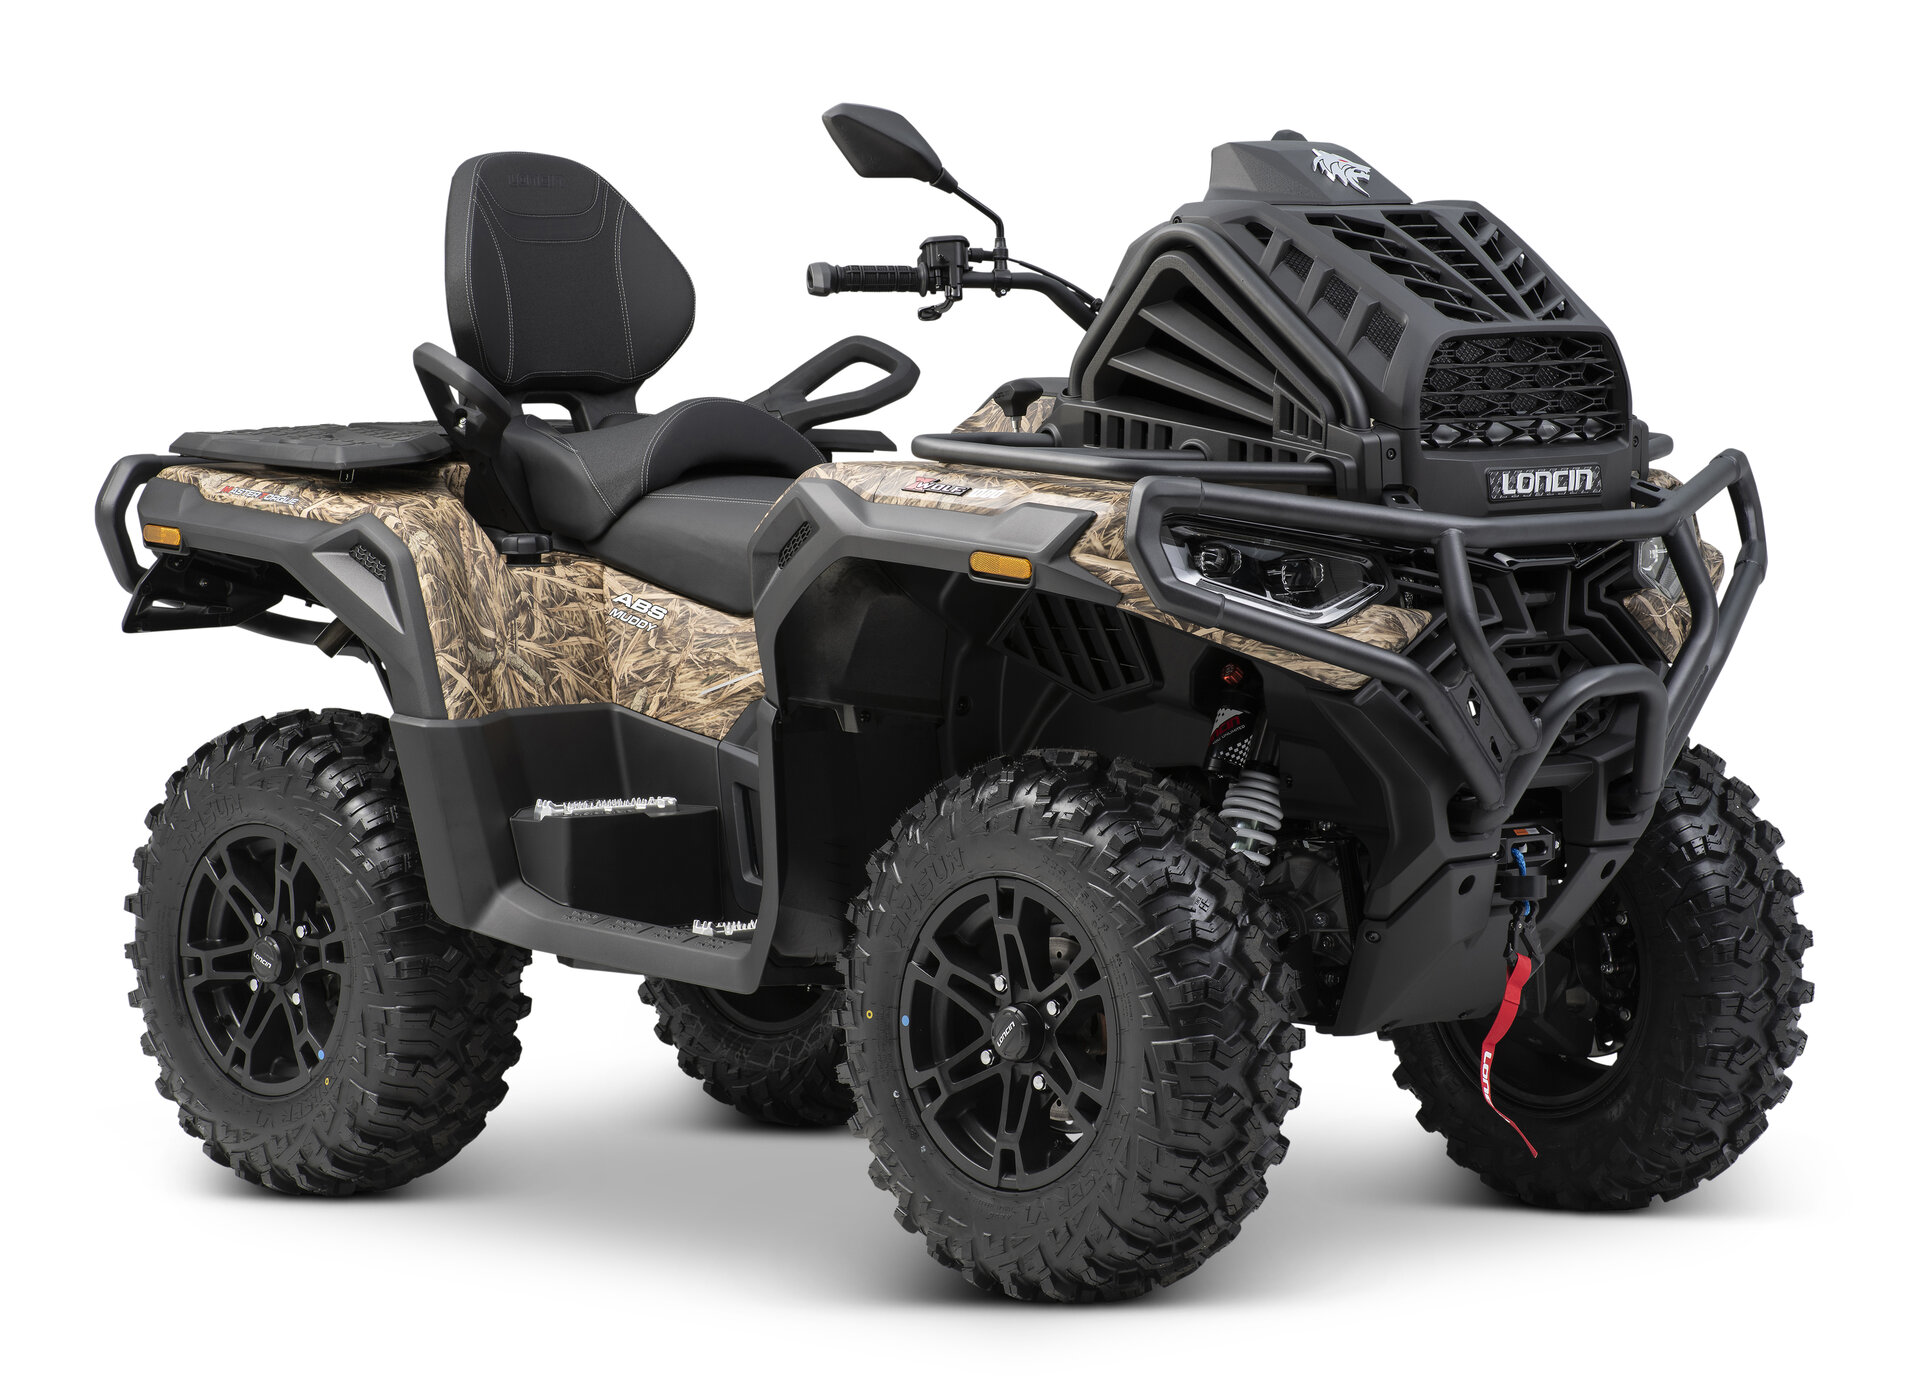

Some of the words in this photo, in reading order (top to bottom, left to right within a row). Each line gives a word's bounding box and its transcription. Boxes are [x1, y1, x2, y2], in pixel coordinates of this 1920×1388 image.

[220, 486, 261, 499] MASTER
[1502, 469, 1593, 495] LONCIN
[611, 593, 668, 620] ABS
[609, 608, 658, 632] MUDDY
[253, 951, 272, 969] LONCIN
[996, 1020, 1016, 1047] LONCIN
